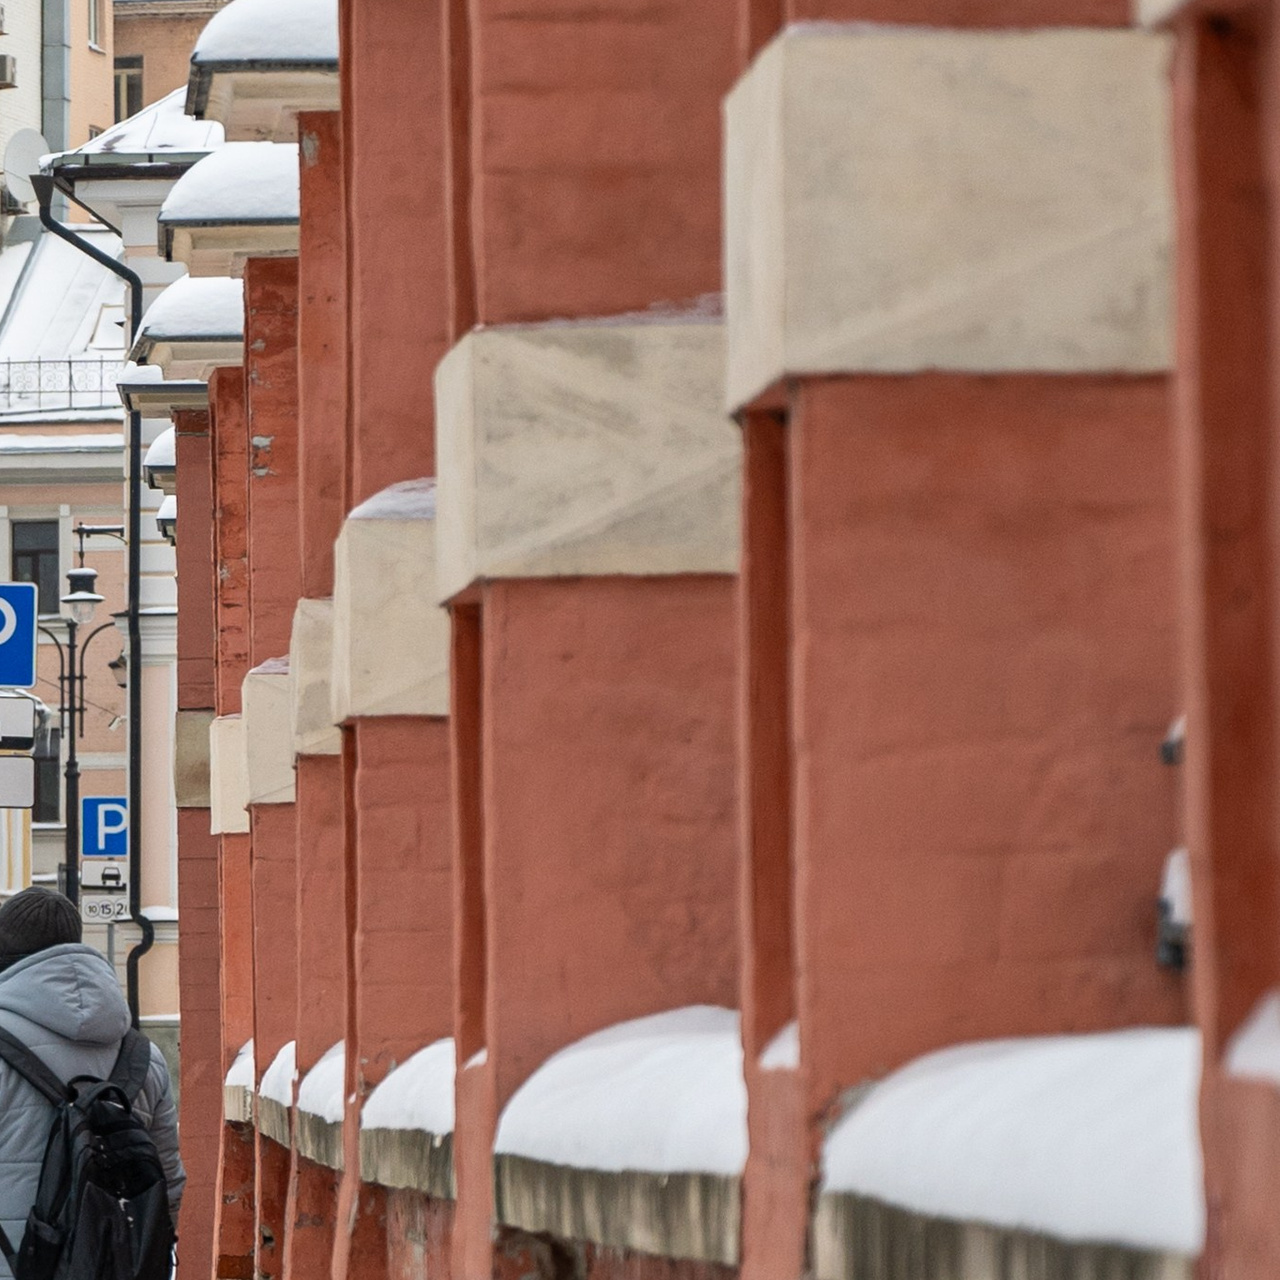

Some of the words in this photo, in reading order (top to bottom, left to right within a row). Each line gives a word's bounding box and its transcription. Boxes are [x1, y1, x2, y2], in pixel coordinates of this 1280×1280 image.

[97, 803, 130, 850] P
[88, 904, 98, 914] 10
[100, 903, 112, 915] 15
